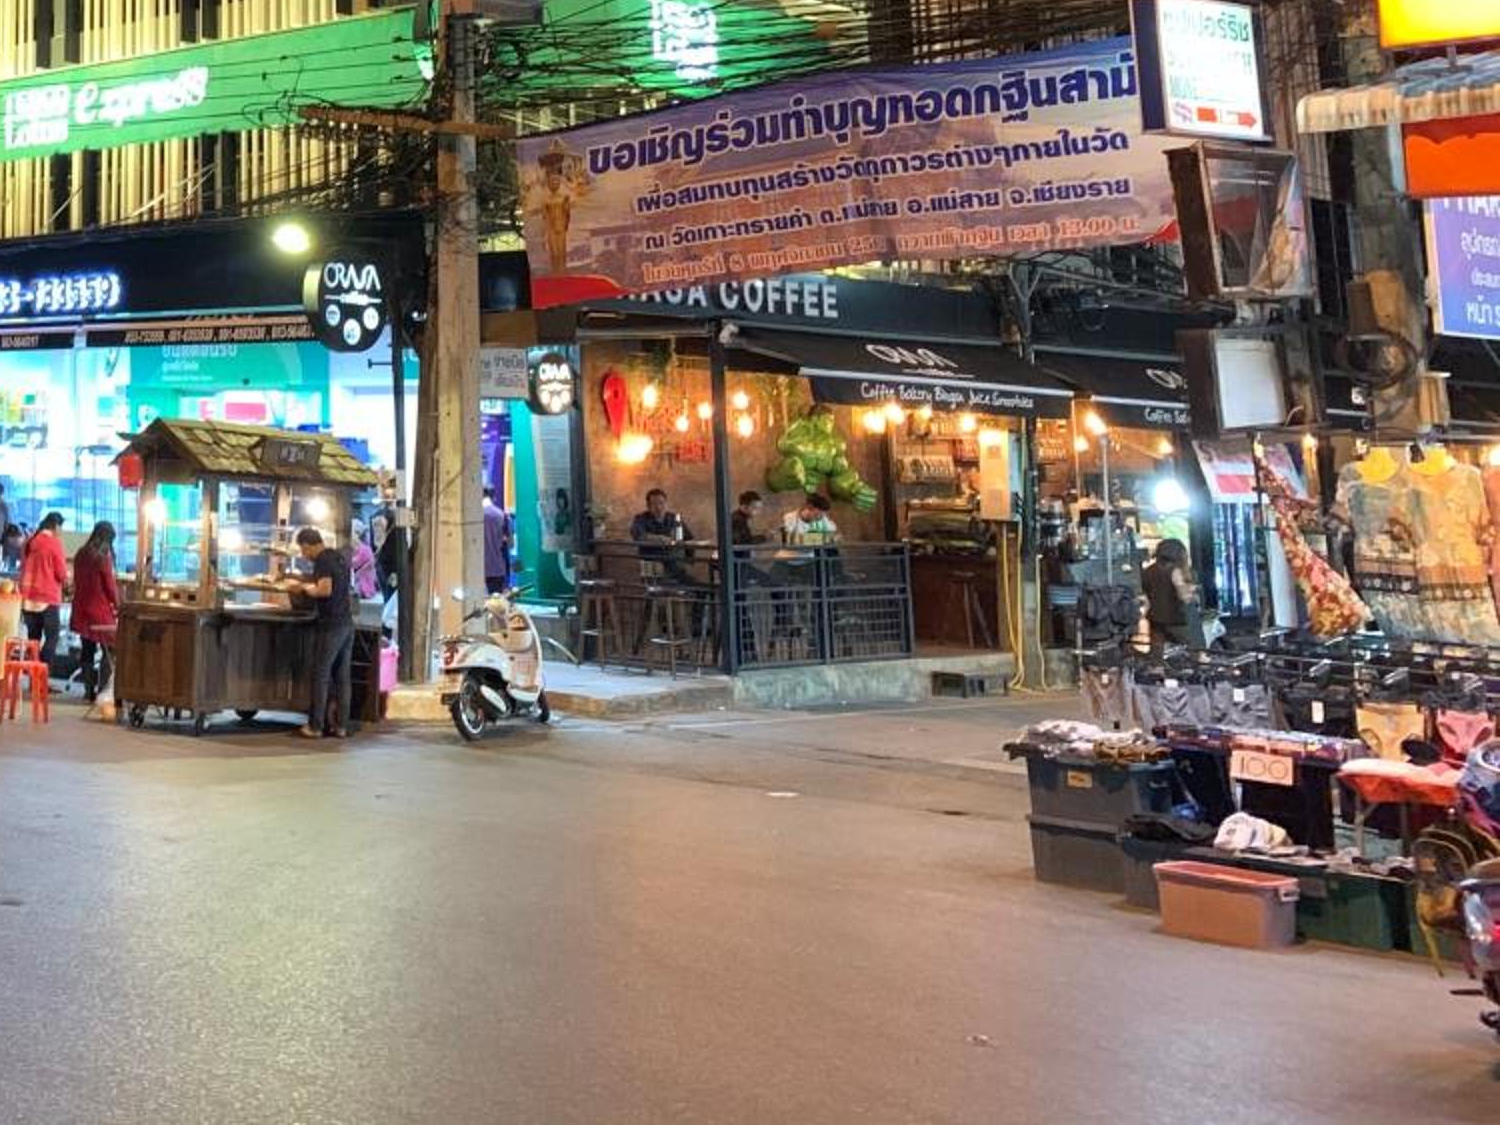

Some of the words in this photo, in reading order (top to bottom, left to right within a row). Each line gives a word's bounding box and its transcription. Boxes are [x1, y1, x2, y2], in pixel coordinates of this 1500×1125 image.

[907, 191, 1000, 214] อ.แม่สาย
[1009, 177, 1130, 207] จ.เชียงราย
[729, 257, 745, 274] 8
[718, 278, 839, 318] COFFEE
[1241, 755, 1289, 779] 100
